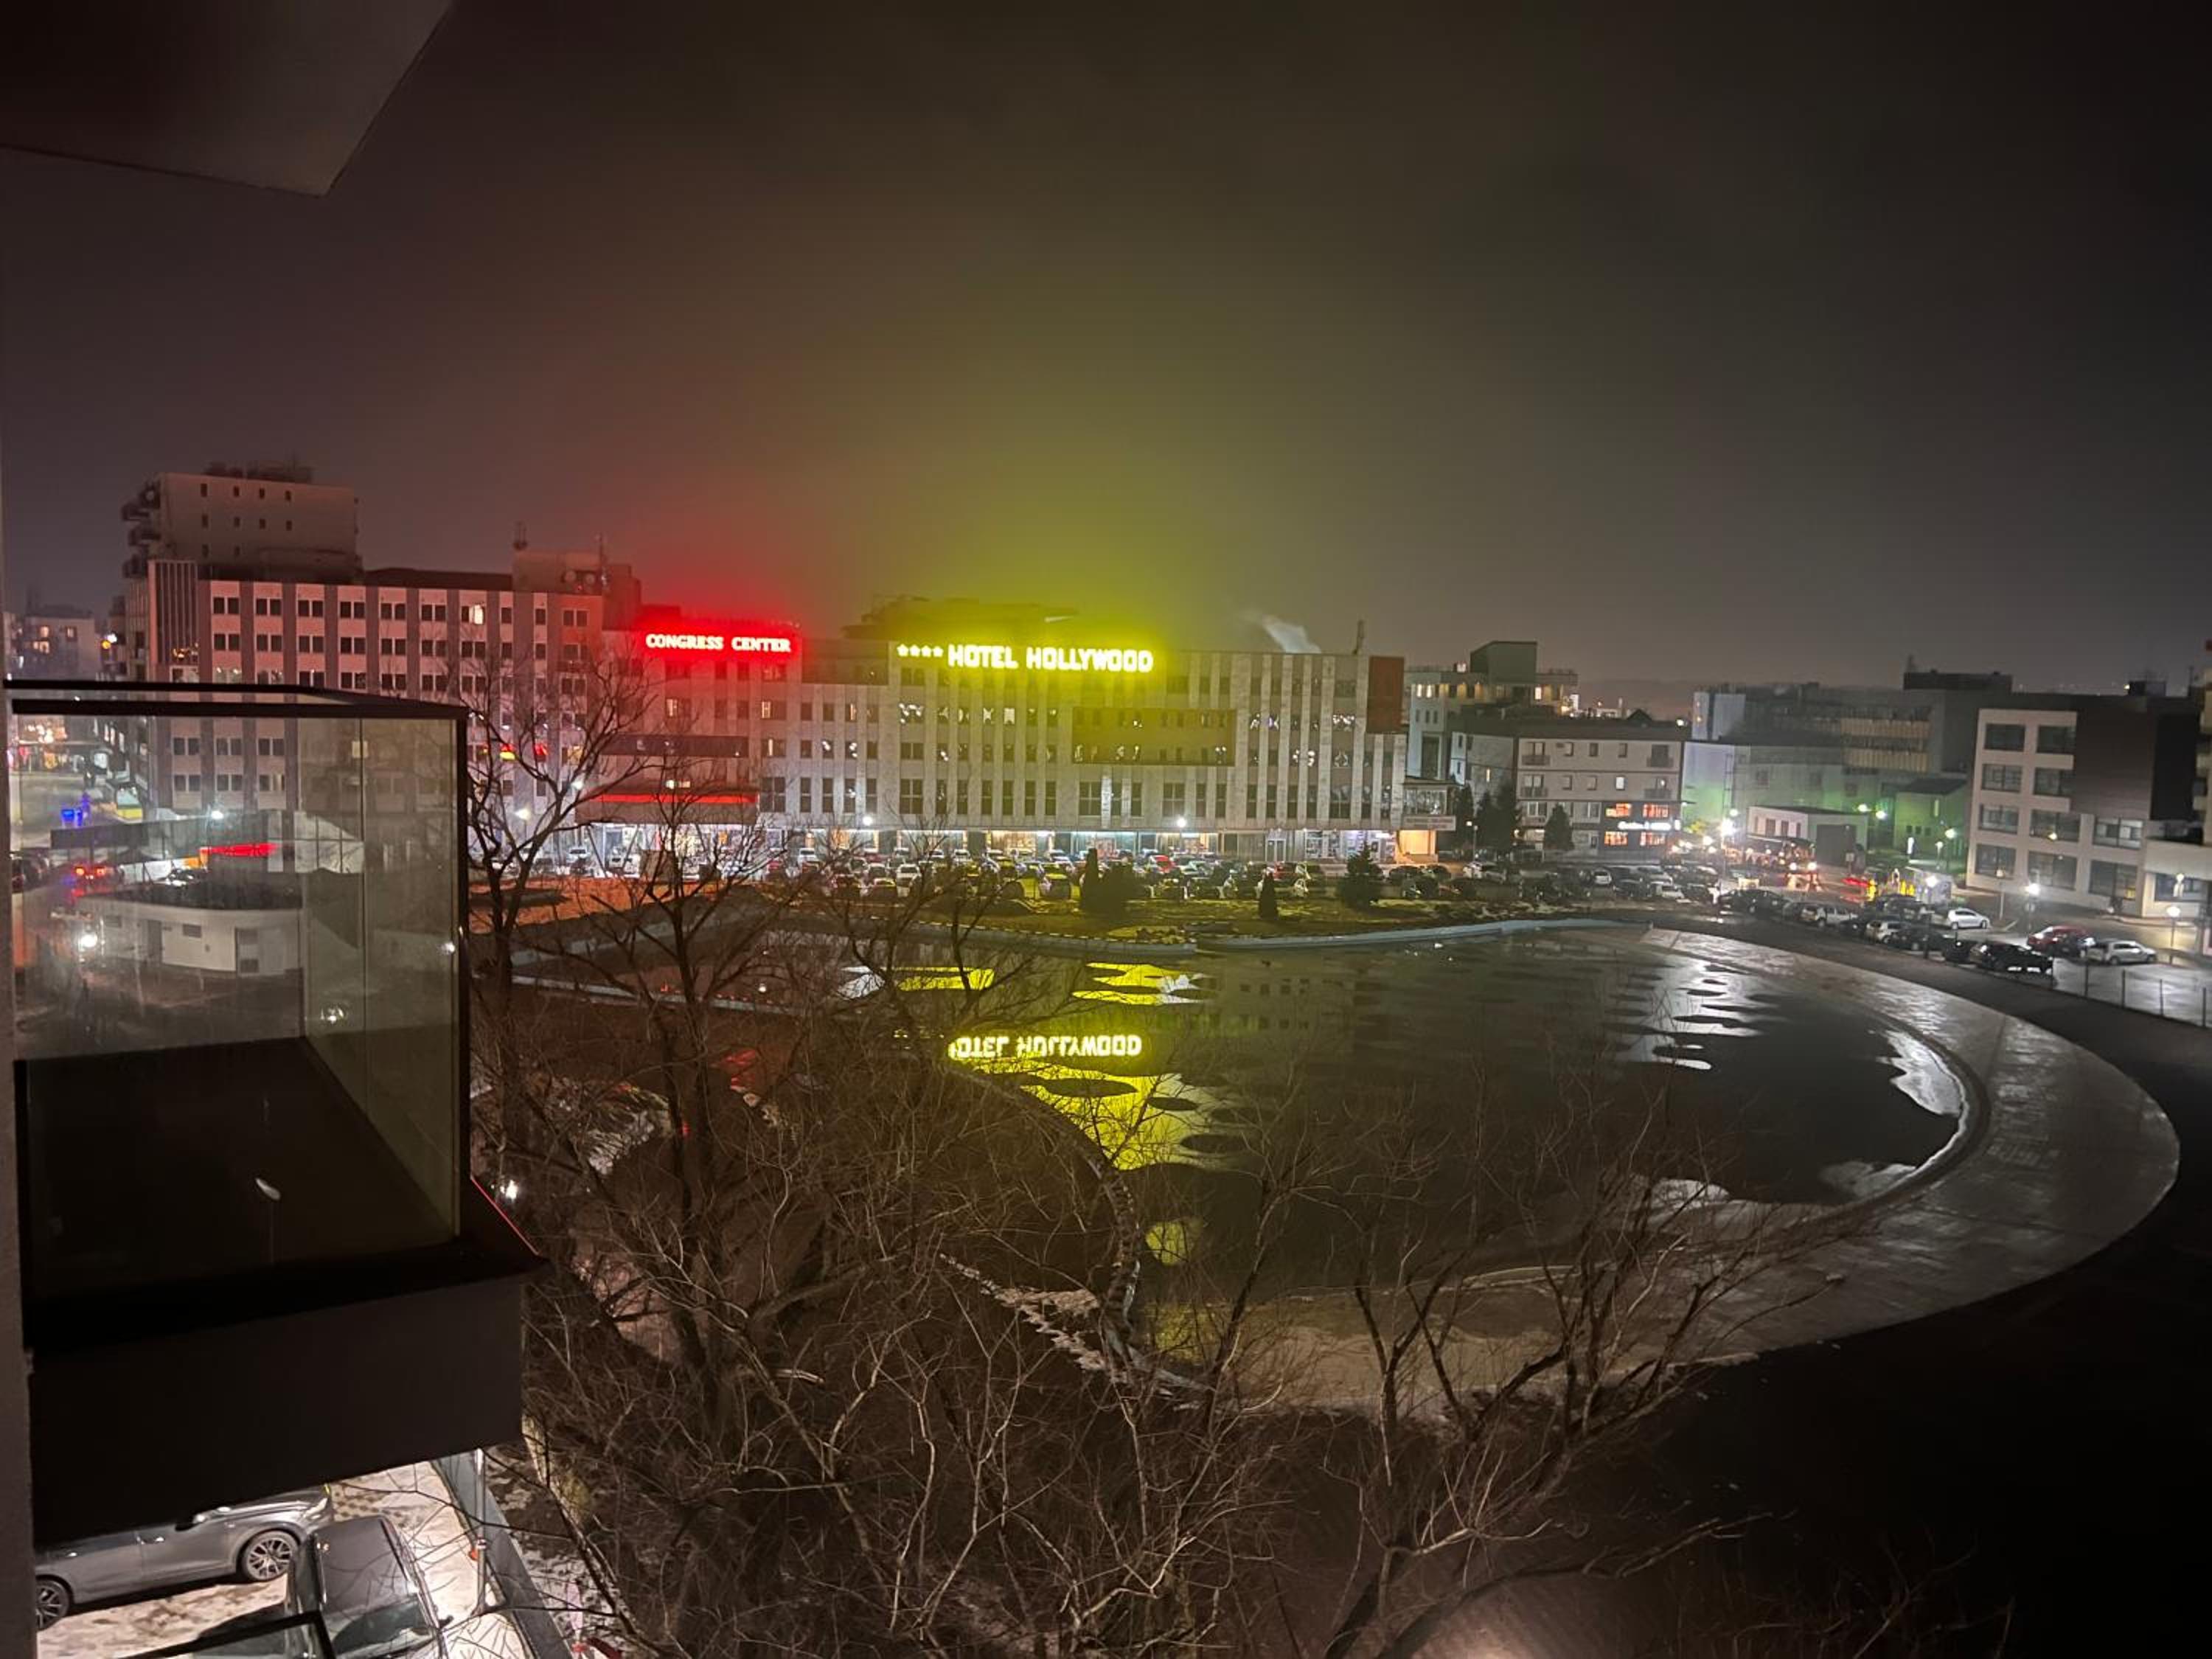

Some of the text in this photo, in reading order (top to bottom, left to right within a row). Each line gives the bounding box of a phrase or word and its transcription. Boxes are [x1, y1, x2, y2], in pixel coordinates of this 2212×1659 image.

[645, 633, 791, 653] CONGRESS CENTER
[947, 643, 1154, 672] HOTEL HOLLYWOOD
